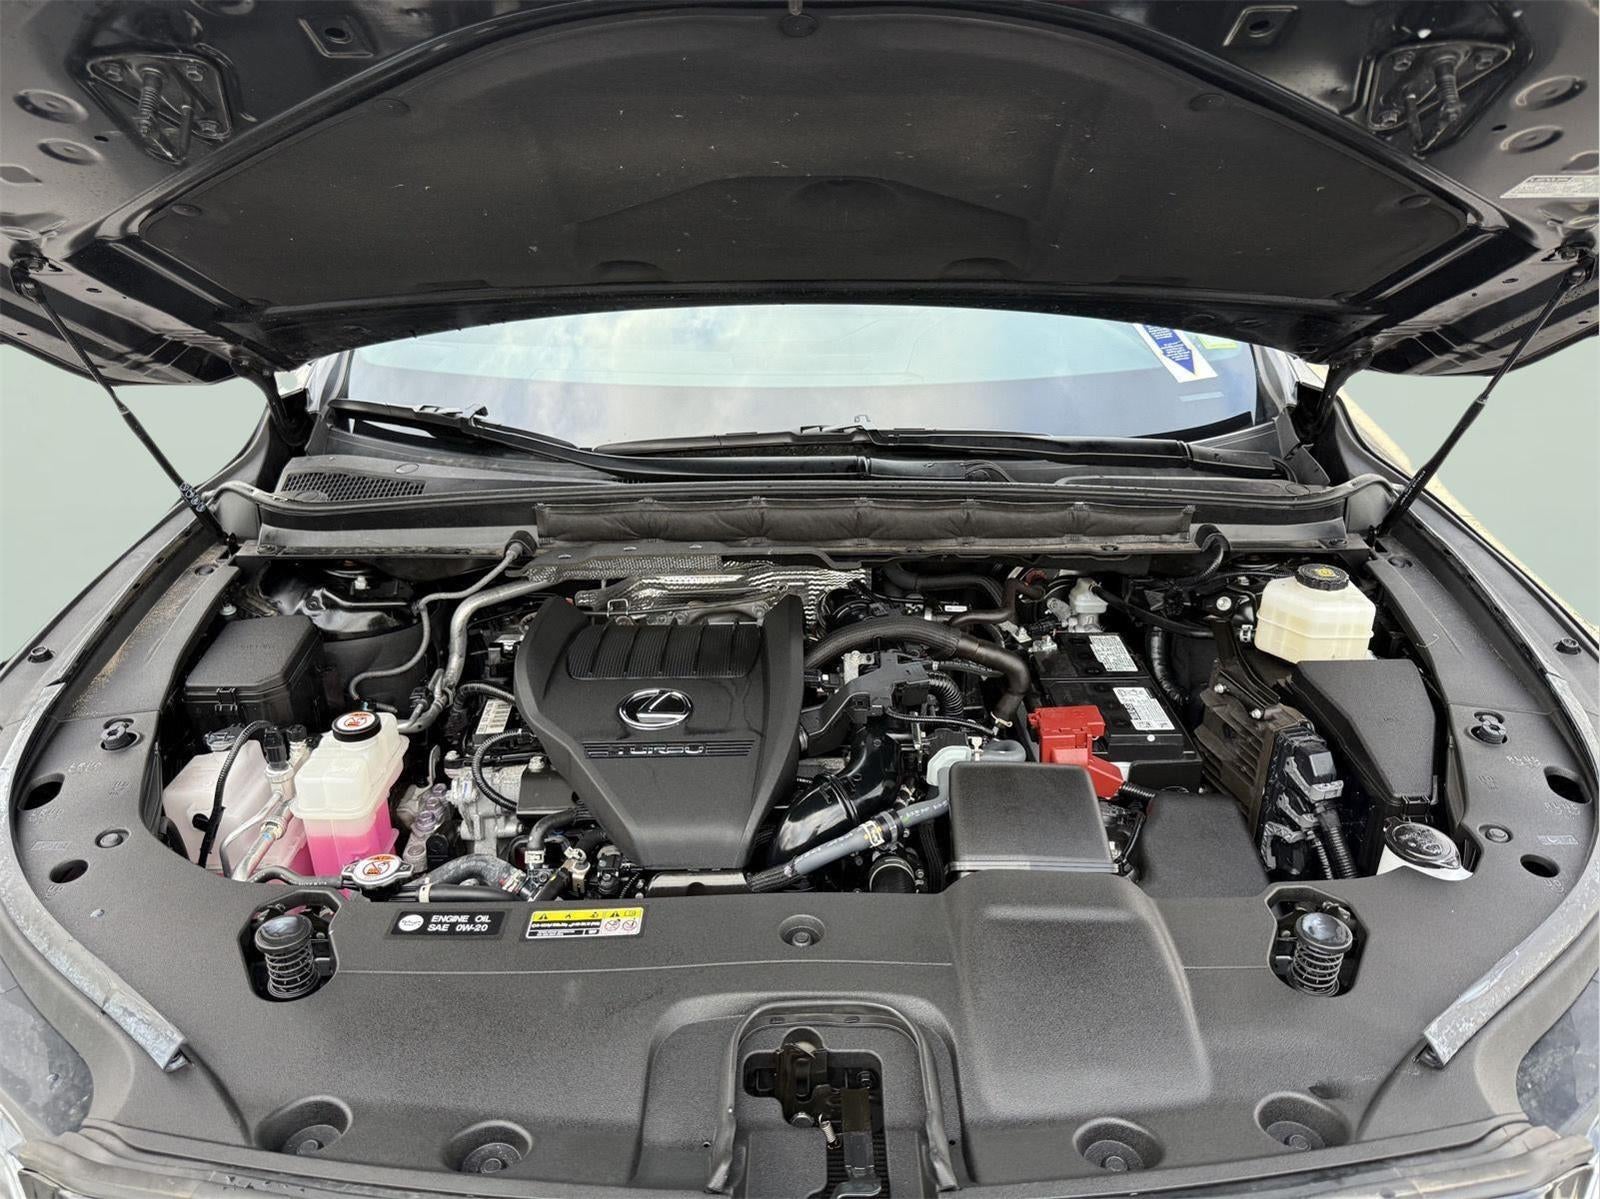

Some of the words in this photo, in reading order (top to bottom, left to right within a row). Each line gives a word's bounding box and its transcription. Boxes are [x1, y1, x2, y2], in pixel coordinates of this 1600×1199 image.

[431, 914, 470, 923] ENGINE
[474, 914, 491, 923] OIL
[427, 923, 450, 932] SAE
[455, 923, 489, 932] 0W-20
